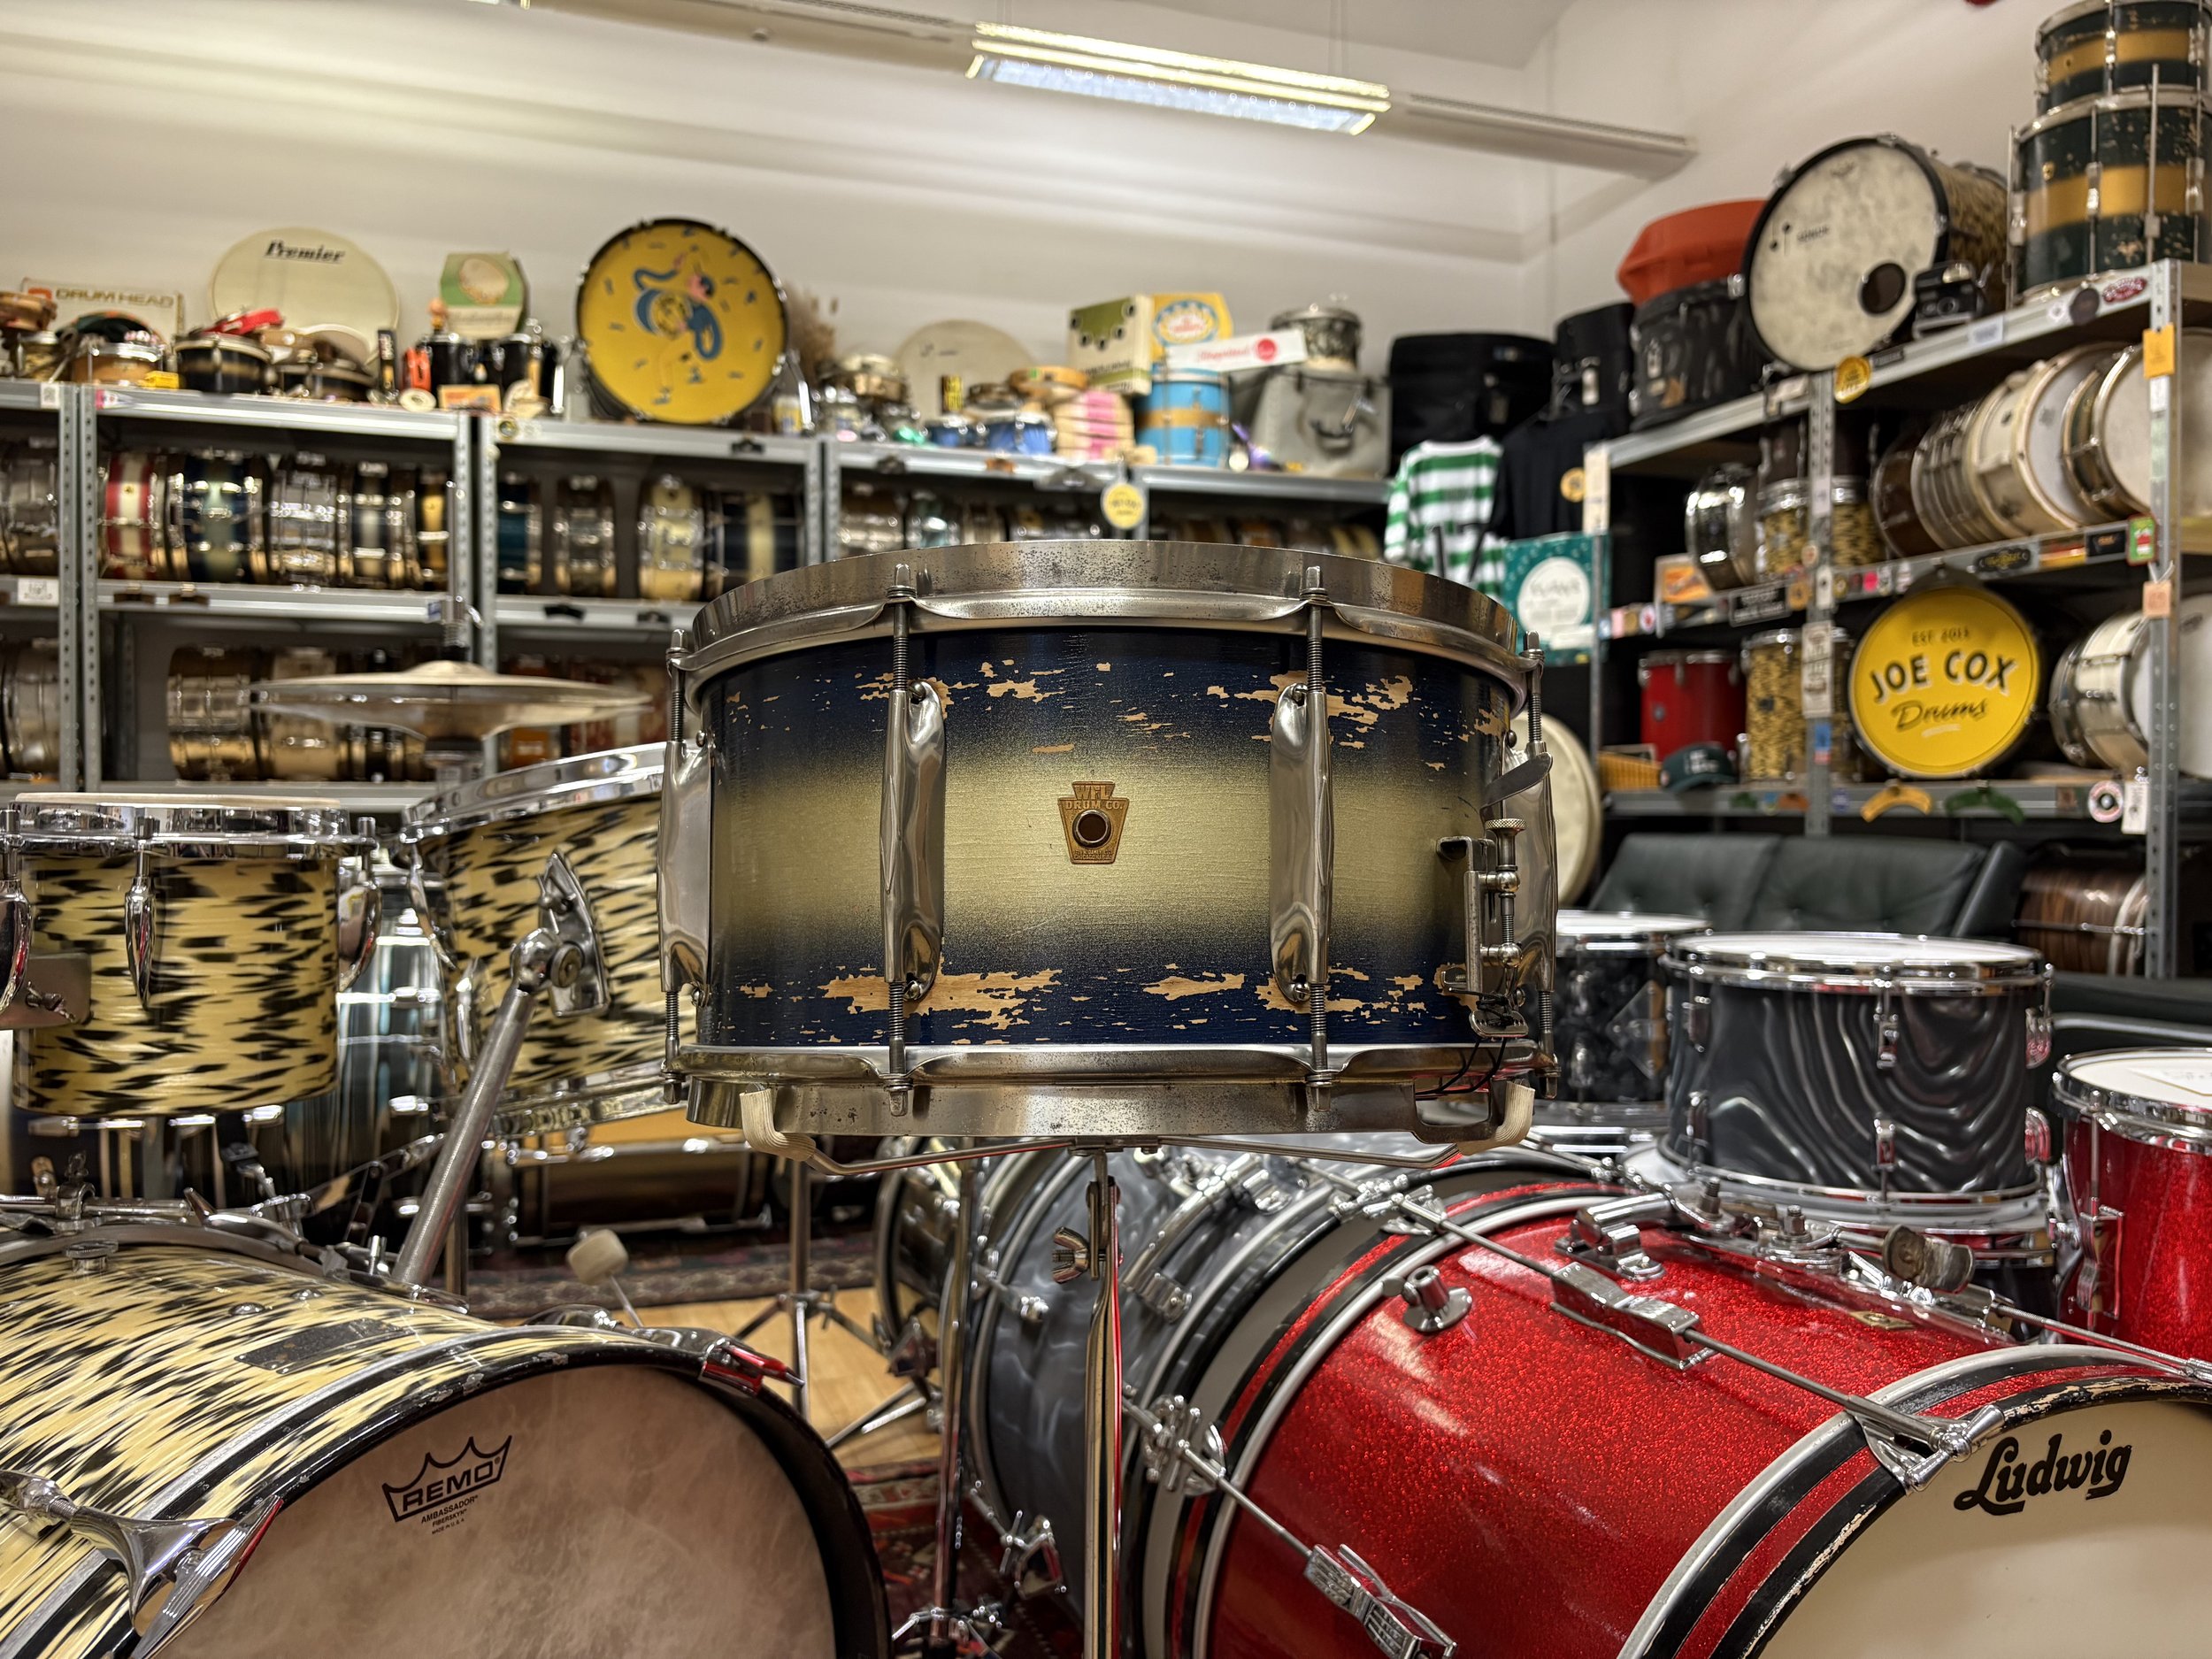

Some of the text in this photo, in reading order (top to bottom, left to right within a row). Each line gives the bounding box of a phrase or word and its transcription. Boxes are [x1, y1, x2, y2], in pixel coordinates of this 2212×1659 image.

[265, 240, 346, 264] Premier
[56, 288, 173, 308] DRUM HEAD
[1870, 654, 1932, 703] JOE
[1944, 649, 2017, 695] COX
[1891, 698, 1988, 733] Drums
[1065, 801, 1123, 810] DRUM CO.
[1074, 785, 1110, 800] WFL
[403, 1460, 494, 1511] REMO
[1954, 1429, 2132, 1516] Ludwig
[421, 1495, 477, 1524] AMBASSADOR
